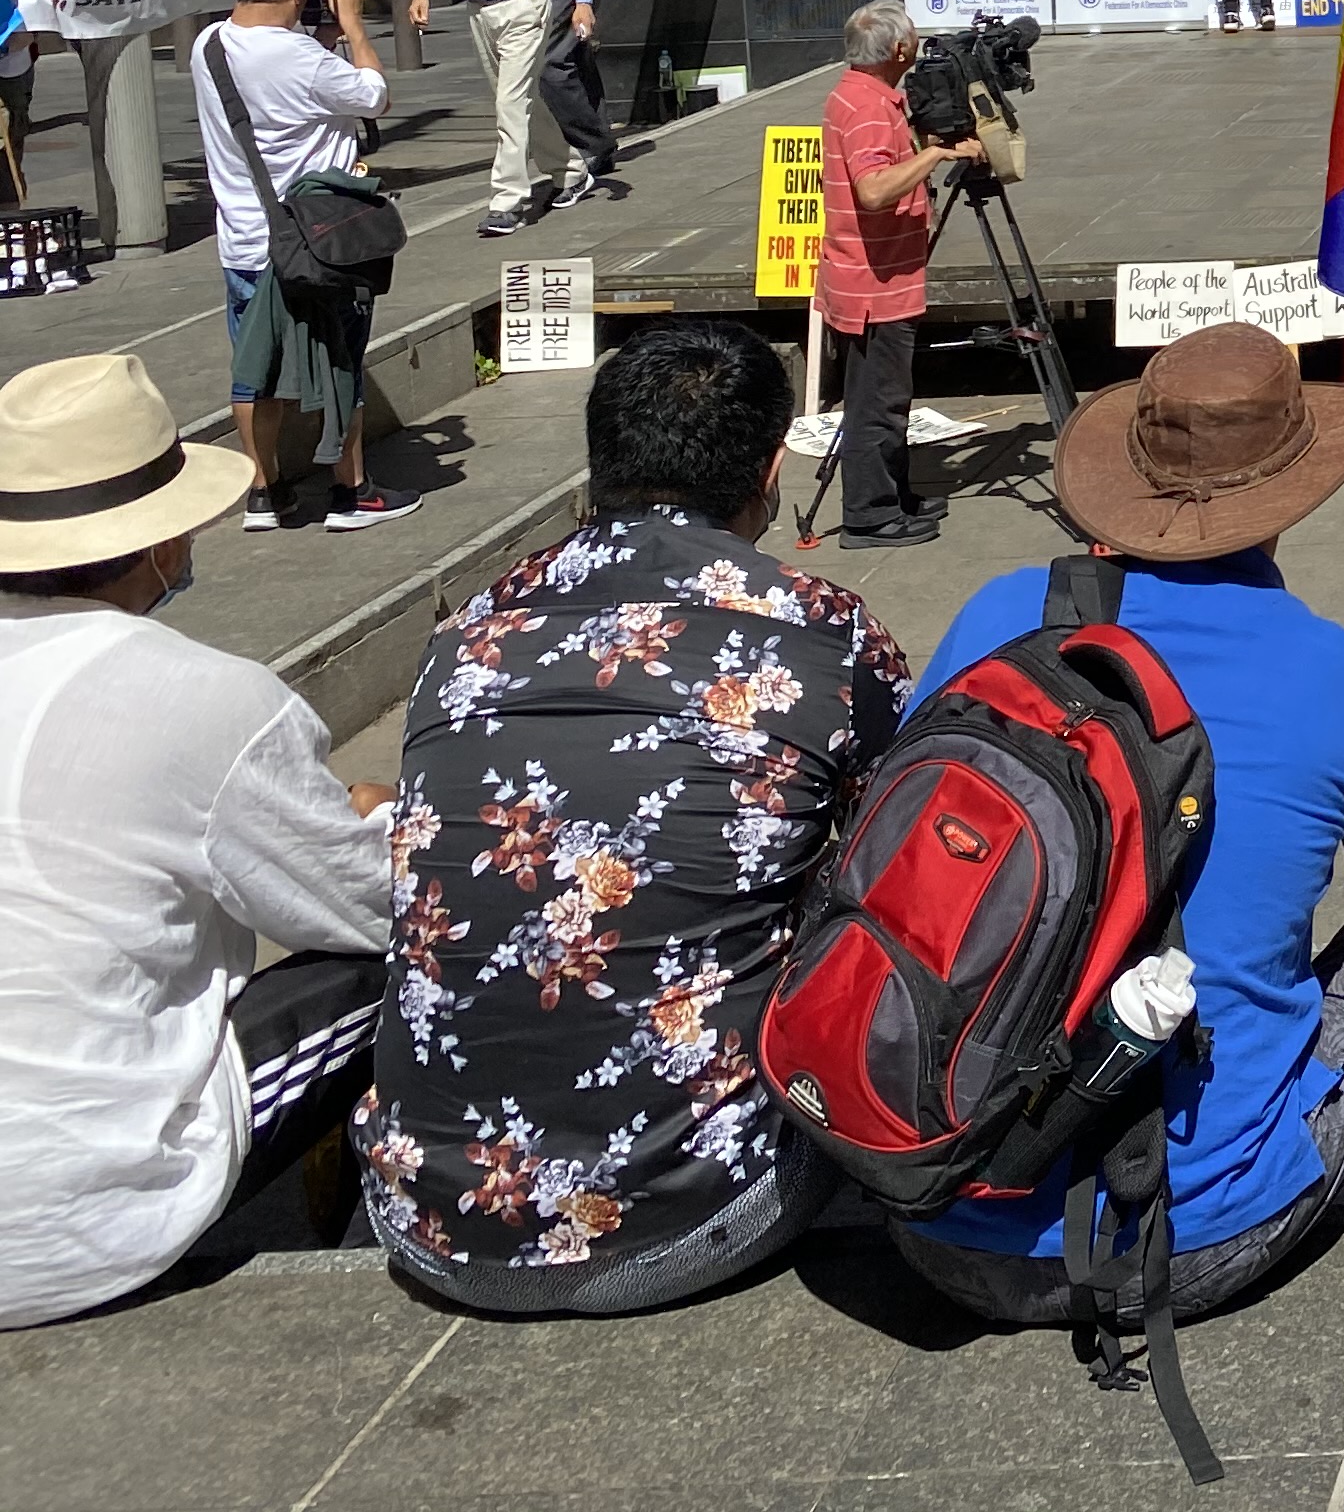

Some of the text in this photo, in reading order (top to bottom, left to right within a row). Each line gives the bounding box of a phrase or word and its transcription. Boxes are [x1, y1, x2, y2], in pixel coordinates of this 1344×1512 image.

[777, 199, 818, 224] THEIR
[768, 236, 795, 260] FOR
[784, 264, 799, 288] IN
[1128, 268, 1228, 297] People of the
[505, 262, 532, 363] FREE CHINA
[541, 266, 572, 361] FREE TIBET
[1128, 299, 1232, 326] World Support
[1244, 294, 1322, 332] Support
[1161, 322, 1182, 339] Us
